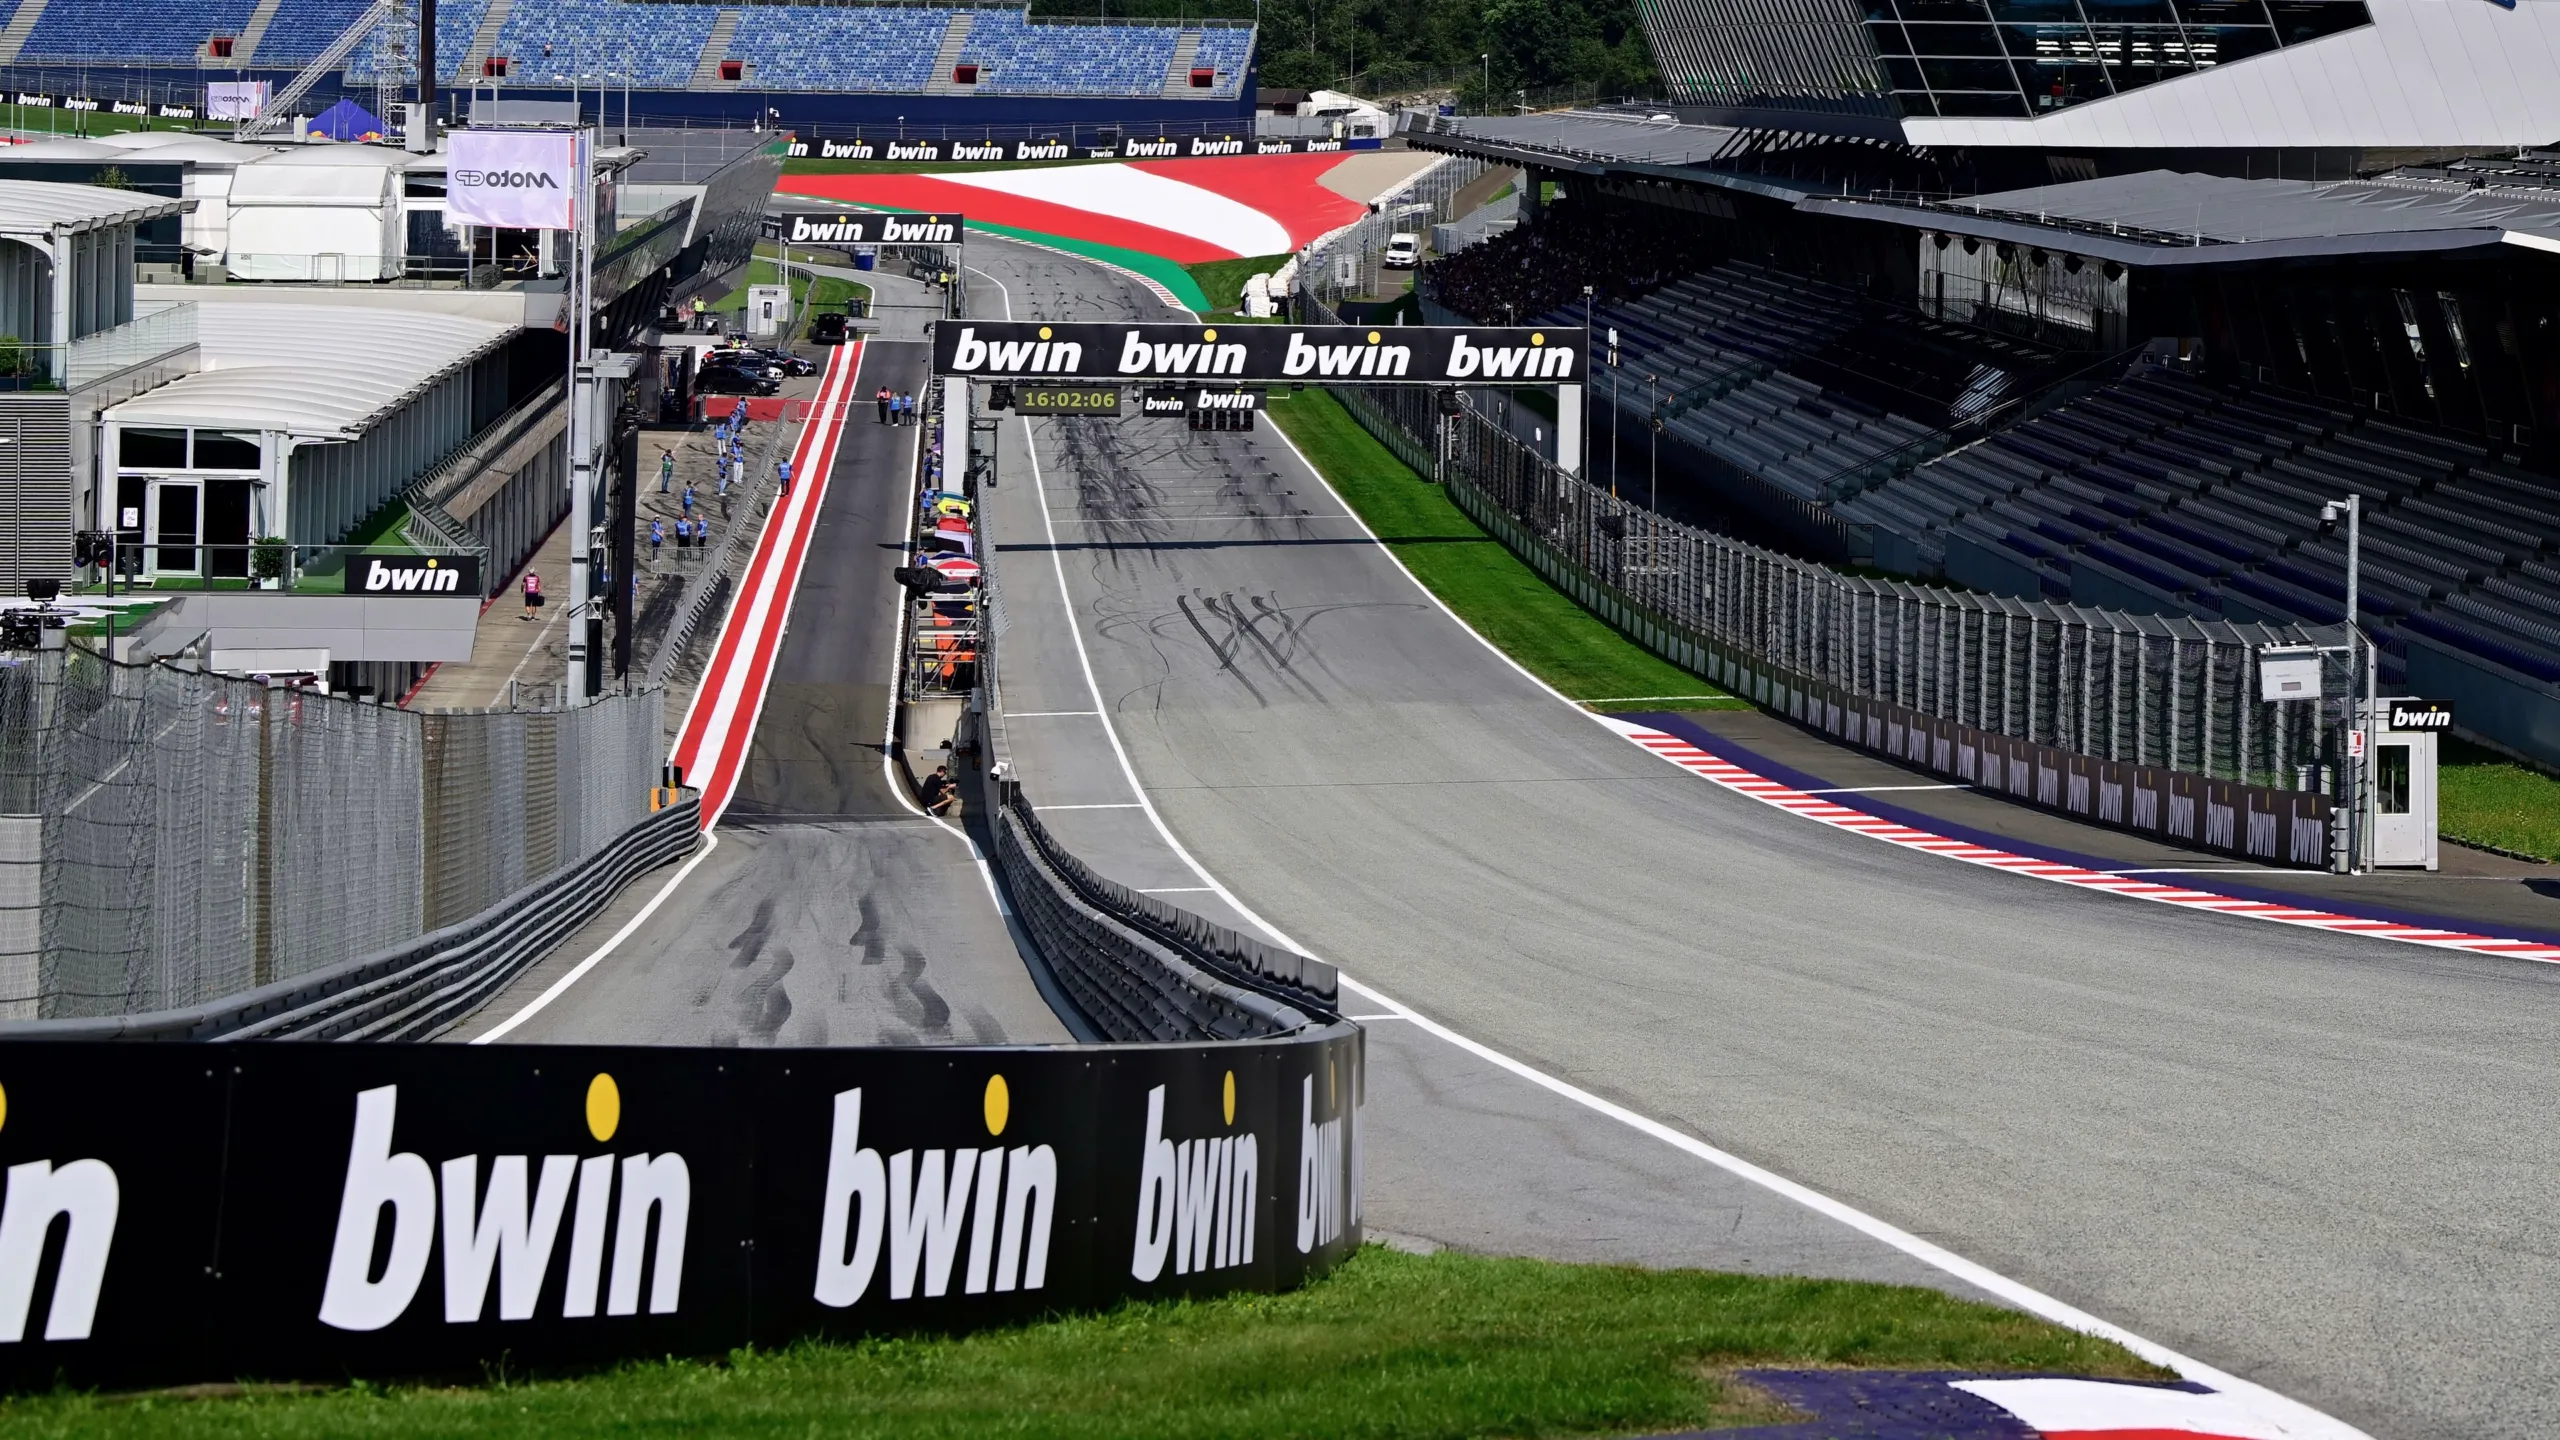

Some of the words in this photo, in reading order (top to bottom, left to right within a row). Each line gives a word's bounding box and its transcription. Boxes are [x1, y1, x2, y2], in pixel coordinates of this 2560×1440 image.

[18, 93, 51, 106] bwin
[65, 97, 98, 110] bwin
[112, 101, 146, 114] bwin
[160, 105, 193, 118] bwin
[787, 137, 808, 156] in
[821, 139, 872, 159] bwin
[887, 140, 937, 160] bwin
[952, 140, 1003, 160] bwin
[1016, 139, 1068, 160] bwin
[1090, 148, 1114, 158] bwin
[1125, 137, 1177, 156] bwin
[1191, 135, 1242, 155] bwin
[1257, 141, 1292, 154] bwin
[1307, 139, 1341, 152] bwin
[792, 215, 864, 241] bwin
[882, 215, 954, 241] bwin
[952, 327, 1083, 373] bwin
[1118, 328, 1248, 374] bwin
[1282, 331, 1411, 376] bwin
[1446, 332, 1575, 377] bwin
[1025, 392, 1115, 408] 16:02:06
[1145, 396, 1183, 411] bwin
[1199, 388, 1255, 409] bwin
[365, 558, 459, 591] bwin
[2392, 706, 2451, 726] bwin
[2067, 757, 2089, 814] bwin
[2099, 764, 2123, 824] bwin
[2132, 769, 2158, 831] bwin
[2168, 776, 2195, 840] bwin
[2205, 784, 2234, 850] bwin
[2246, 791, 2277, 858] bwin
[2290, 795, 2323, 865] bwin
[318, 1073, 690, 1331] bwin
[813, 1074, 1058, 1307] bwin
[1131, 1070, 1258, 1282] bwin
[1297, 1060, 1341, 1254] bwin
